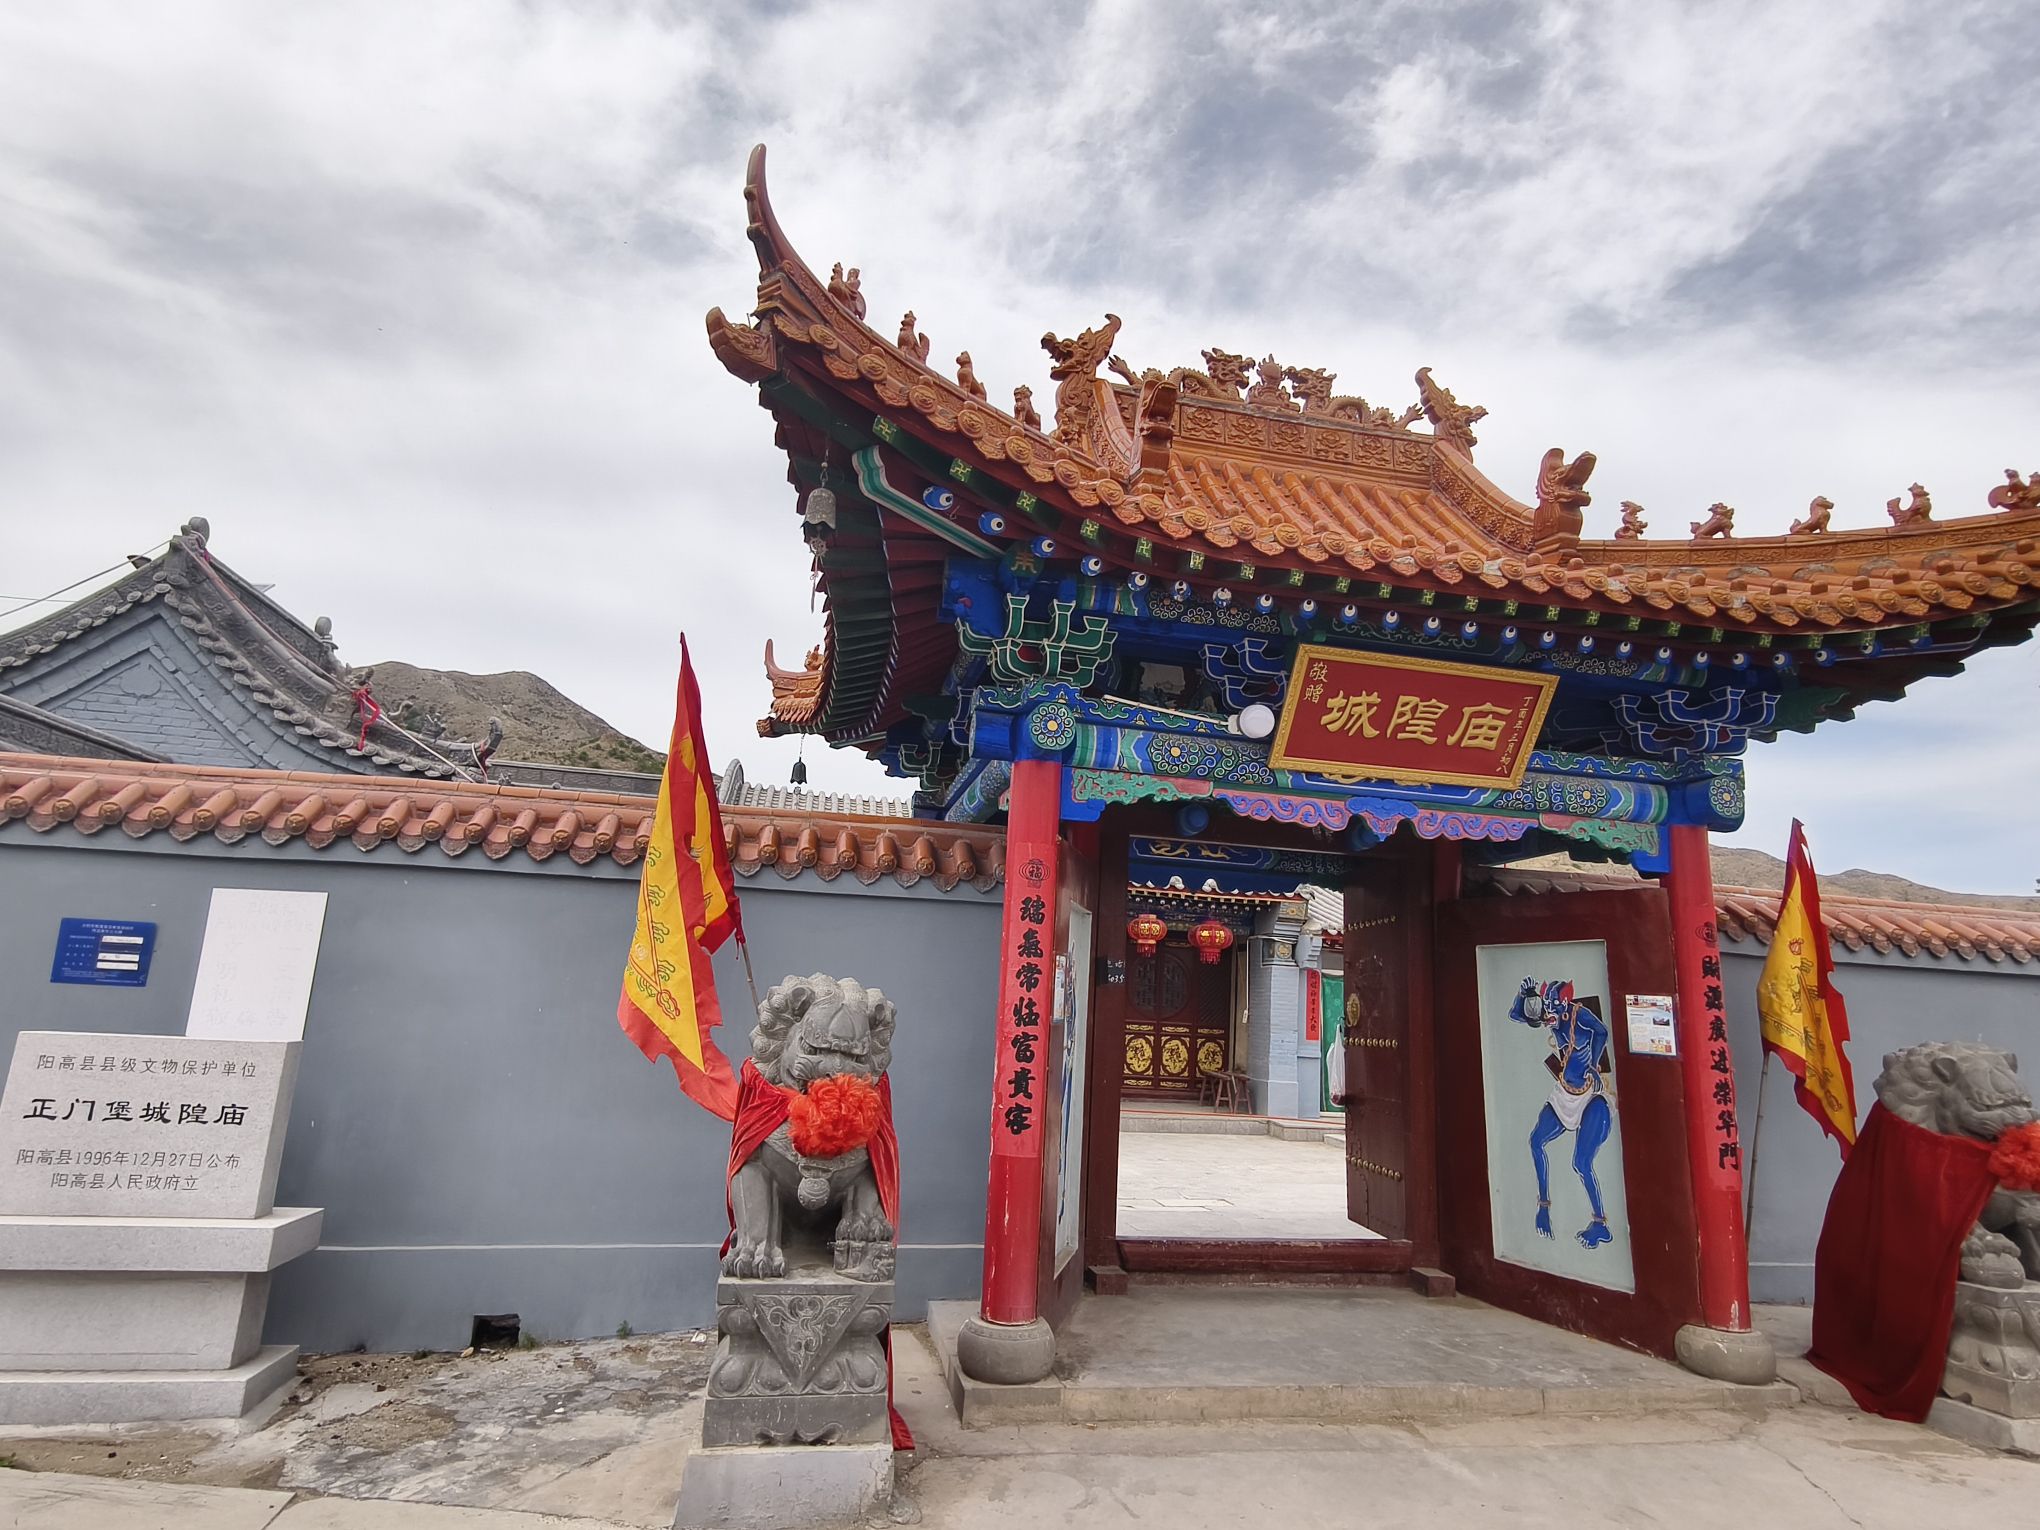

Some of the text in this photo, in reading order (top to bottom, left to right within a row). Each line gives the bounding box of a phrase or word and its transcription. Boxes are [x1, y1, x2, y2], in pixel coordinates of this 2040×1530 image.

[1320, 689, 1513, 752] 城隍庙
[36, 1054, 257, 1078] 阳高县县级文物保护单位
[23, 1098, 249, 1126] 正门堡城隍庙
[16, 1149, 240, 1169] 阳高县1996年12月27日公布
[51, 1173, 200, 1192] 阳高县人民政府立
